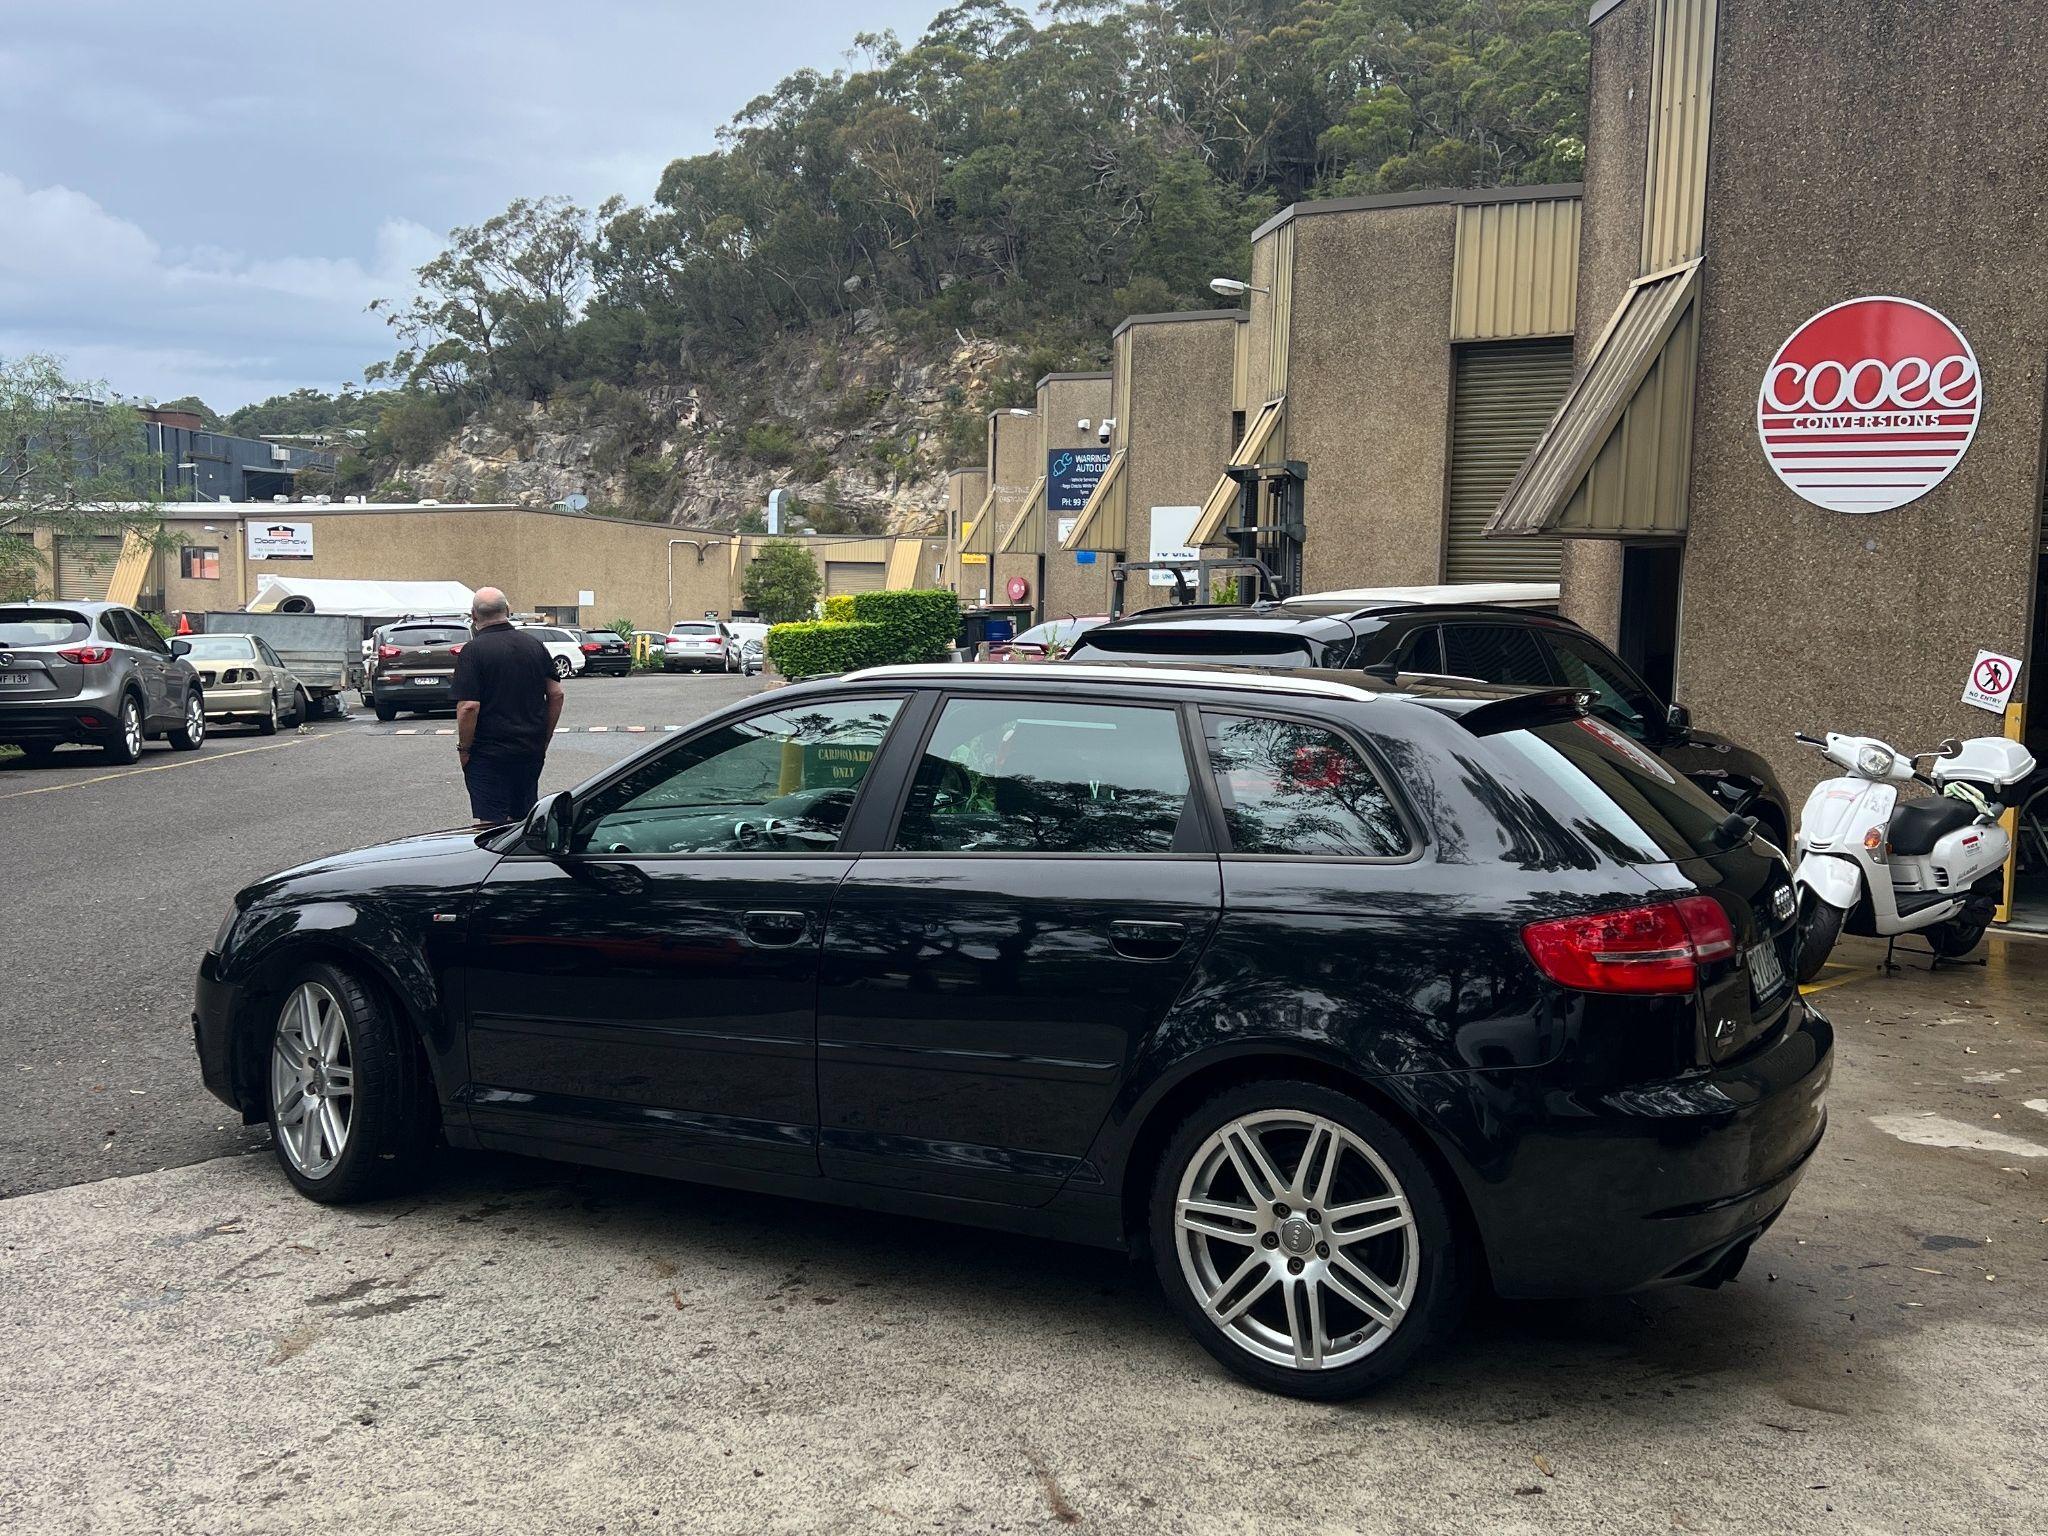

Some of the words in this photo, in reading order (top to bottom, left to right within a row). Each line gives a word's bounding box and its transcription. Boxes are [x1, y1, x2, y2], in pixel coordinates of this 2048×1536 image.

[1765, 355, 1978, 412] cooee
[1792, 414, 1941, 429] CONVERSIONS
[1076, 464, 1094, 472] AUTO
[1980, 694, 2001, 703] ENTRY
[833, 766, 855, 778] ONLY
